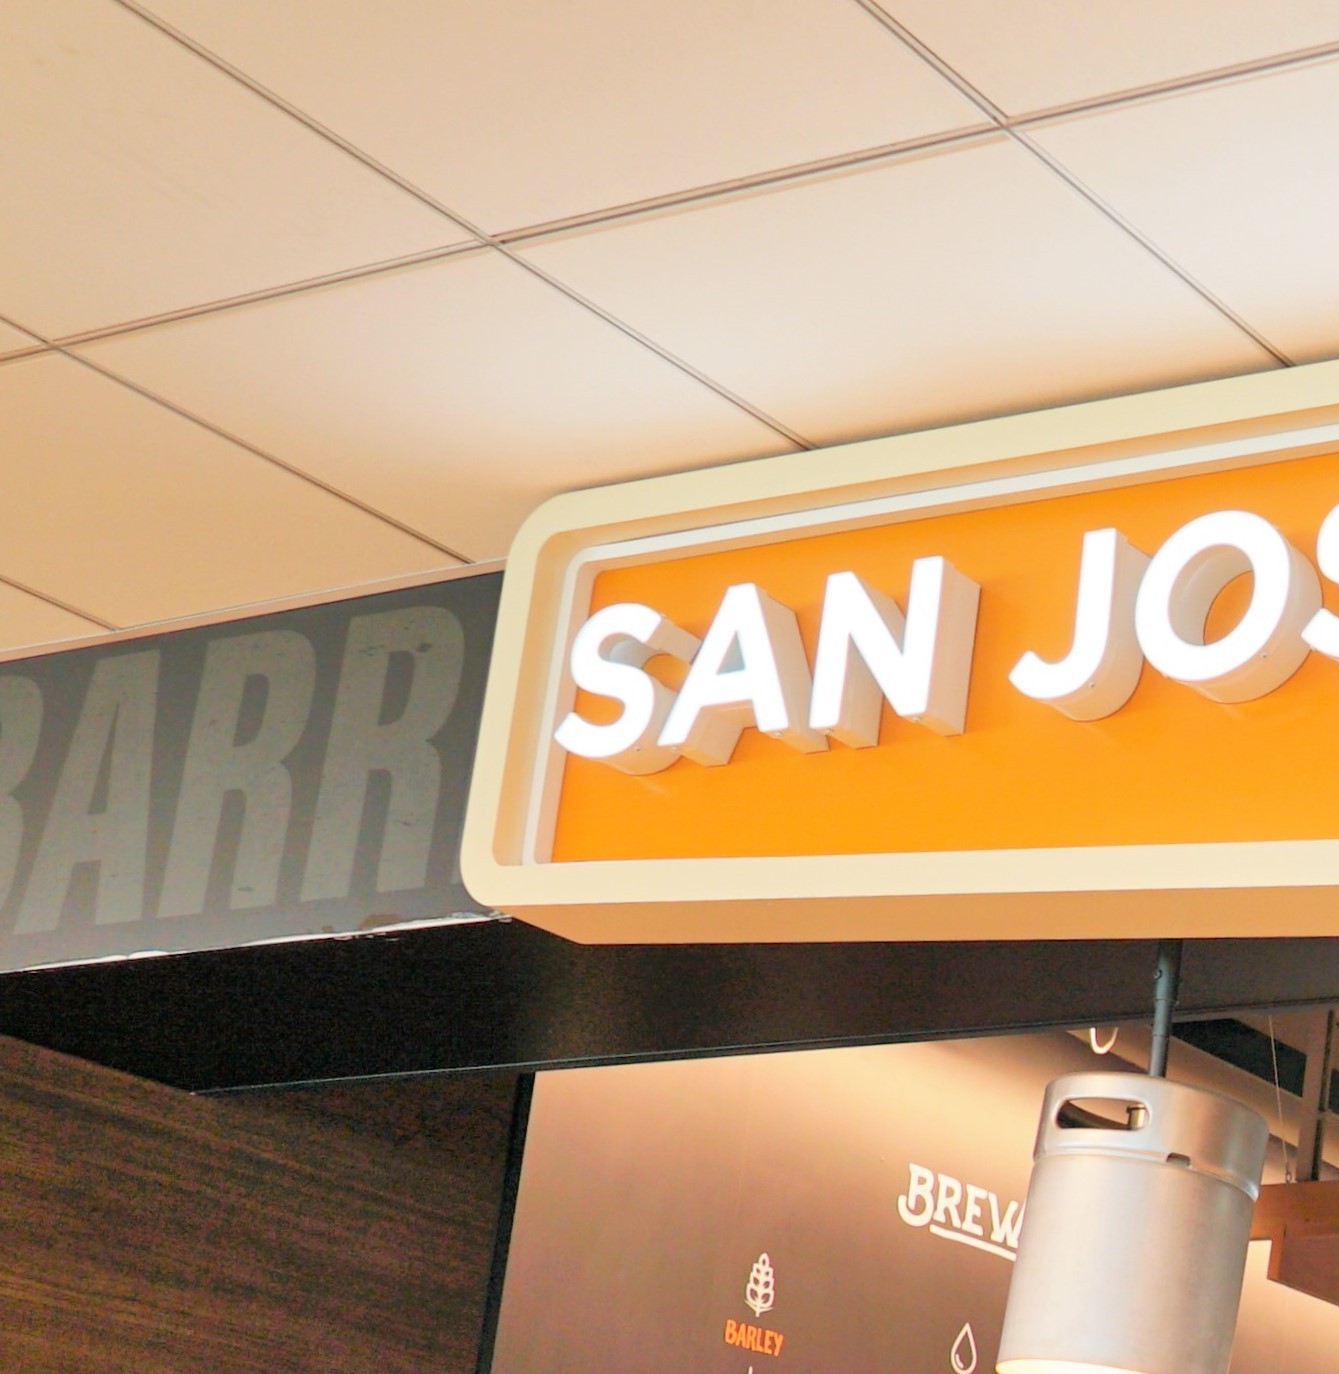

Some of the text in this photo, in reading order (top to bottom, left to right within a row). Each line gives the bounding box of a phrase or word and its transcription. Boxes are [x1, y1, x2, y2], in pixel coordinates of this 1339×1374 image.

[554, 554, 946, 759] SAN
[0, 605, 464, 936] ARR
[724, 1319, 784, 1356] BARLEY
